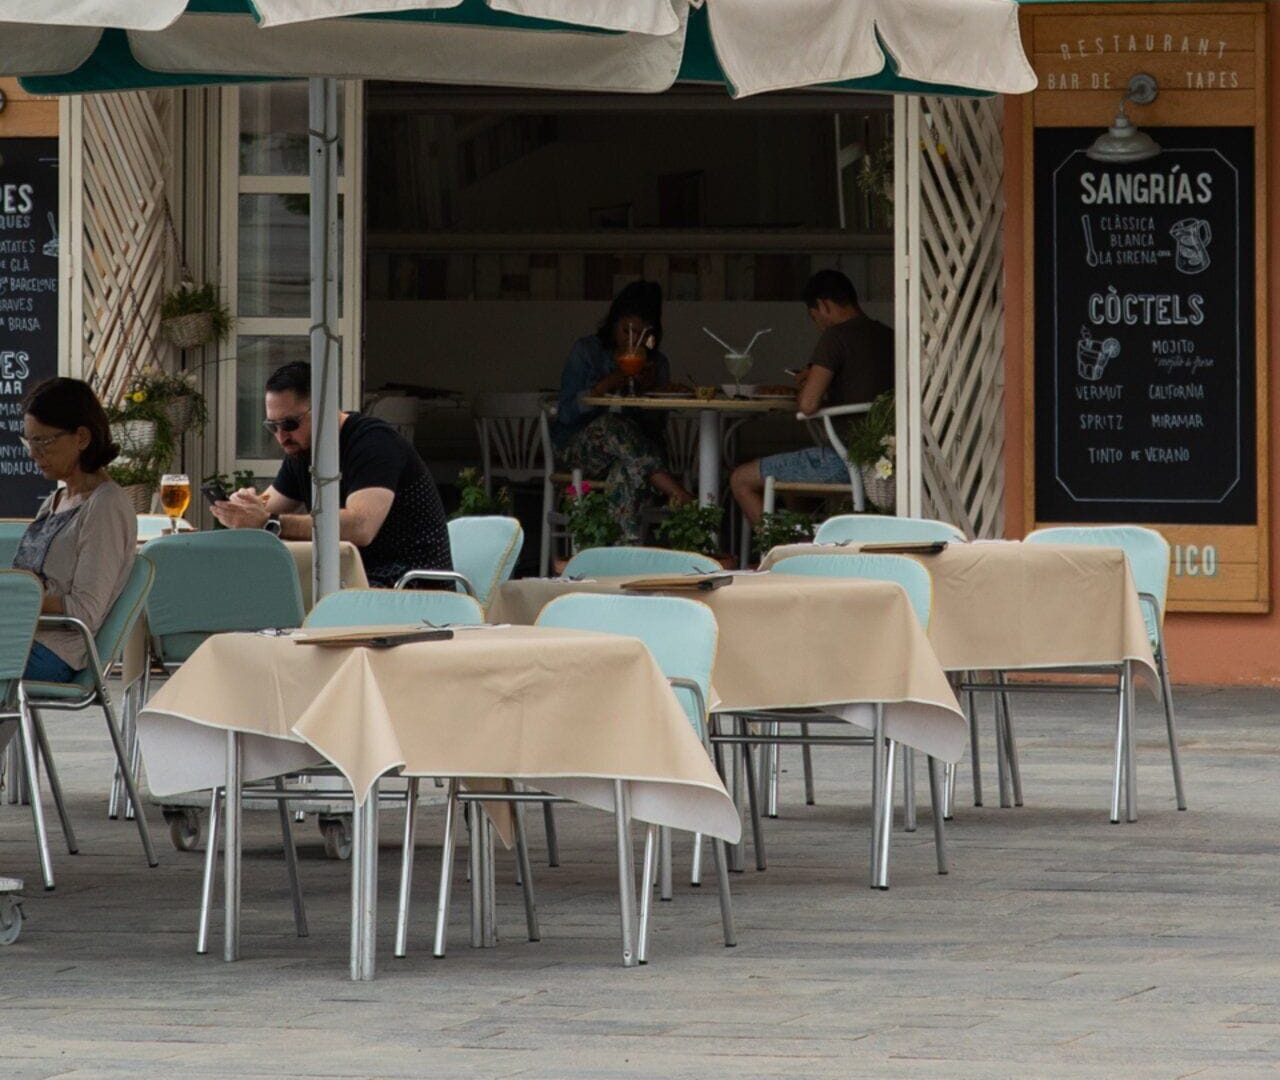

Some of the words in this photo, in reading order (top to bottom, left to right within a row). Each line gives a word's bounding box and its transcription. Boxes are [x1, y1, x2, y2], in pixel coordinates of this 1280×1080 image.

[1060, 34, 1227, 61] RESTAURANT
[1047, 73, 1080, 90] BAR
[1091, 72, 1112, 89] DE
[1186, 71, 1239, 89] TAPES
[1080, 164, 1213, 205] SANGRÍAS
[1110, 233, 1155, 247] BLANCA
[1099, 251, 1113, 265] LA
[1116, 250, 1158, 265] SIRENA
[9, 277, 58, 293] BARCELONE
[1088, 284, 1205, 326] CÒCTELS
[8, 317, 41, 332] BRASA
[1152, 338, 1195, 355] MOJITO
[1075, 384, 1124, 401] VERMUT
[1148, 382, 1205, 400] CALIFORNIA
[0, 403, 24, 416] MAR
[8, 420, 26, 433] VAP
[1080, 413, 1124, 431] SPRITZ
[1151, 413, 1204, 429] MIRAMAR
[1088, 446, 1123, 464] TINTO
[1144, 445, 1191, 464] VERANO
[1175, 543, 1218, 577] ICO
